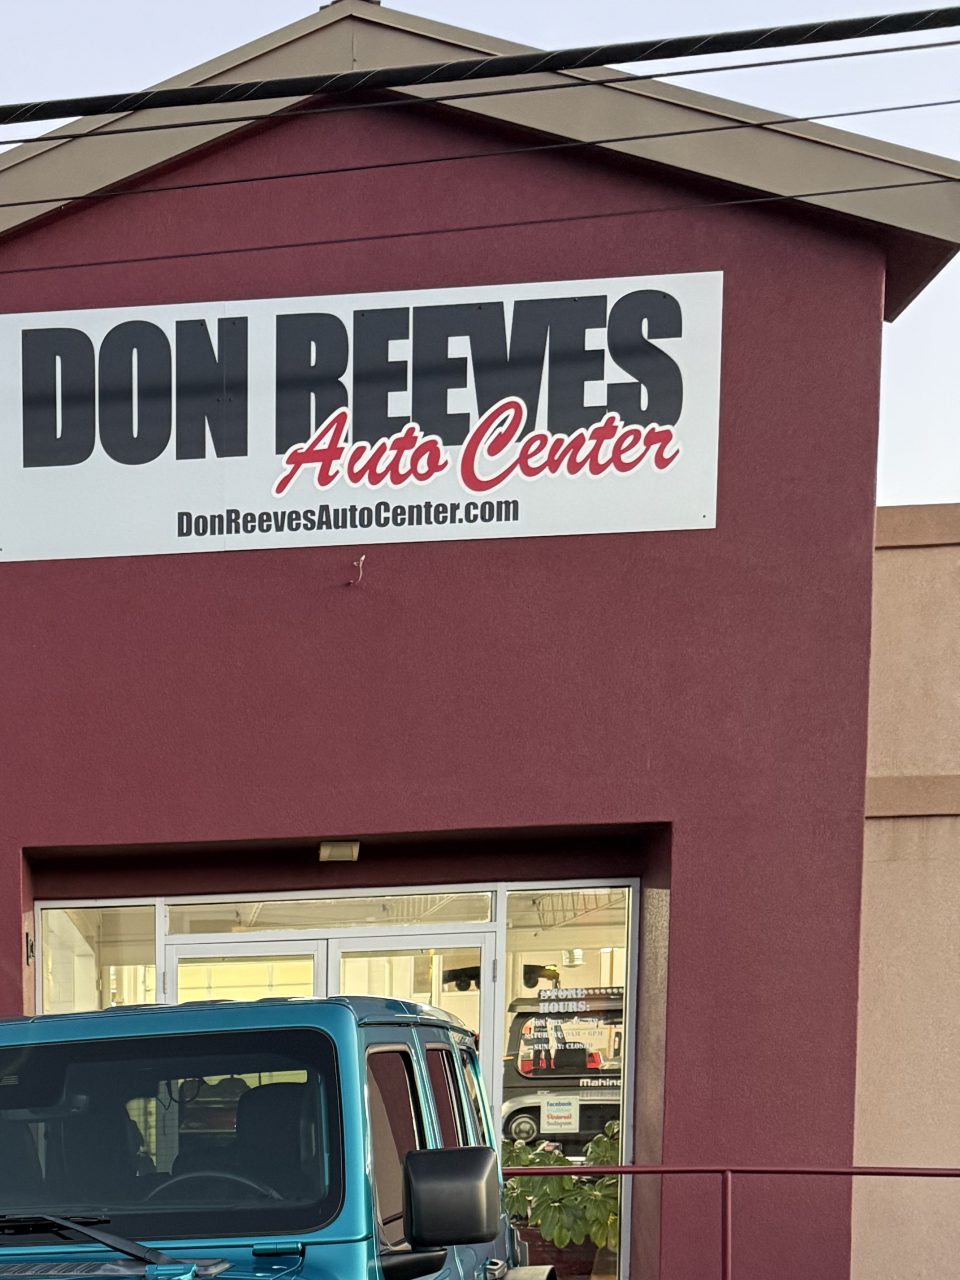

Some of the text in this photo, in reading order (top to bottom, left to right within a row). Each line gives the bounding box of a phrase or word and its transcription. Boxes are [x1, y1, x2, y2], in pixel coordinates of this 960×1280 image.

[21, 289, 682, 468] DON REEVES
[273, 395, 680, 497] Auto Center
[177, 499, 520, 538] DonReevesAutoCenter.com
[539, 1000, 590, 1014] HOURS:
[540, 987, 586, 1000] STORE
